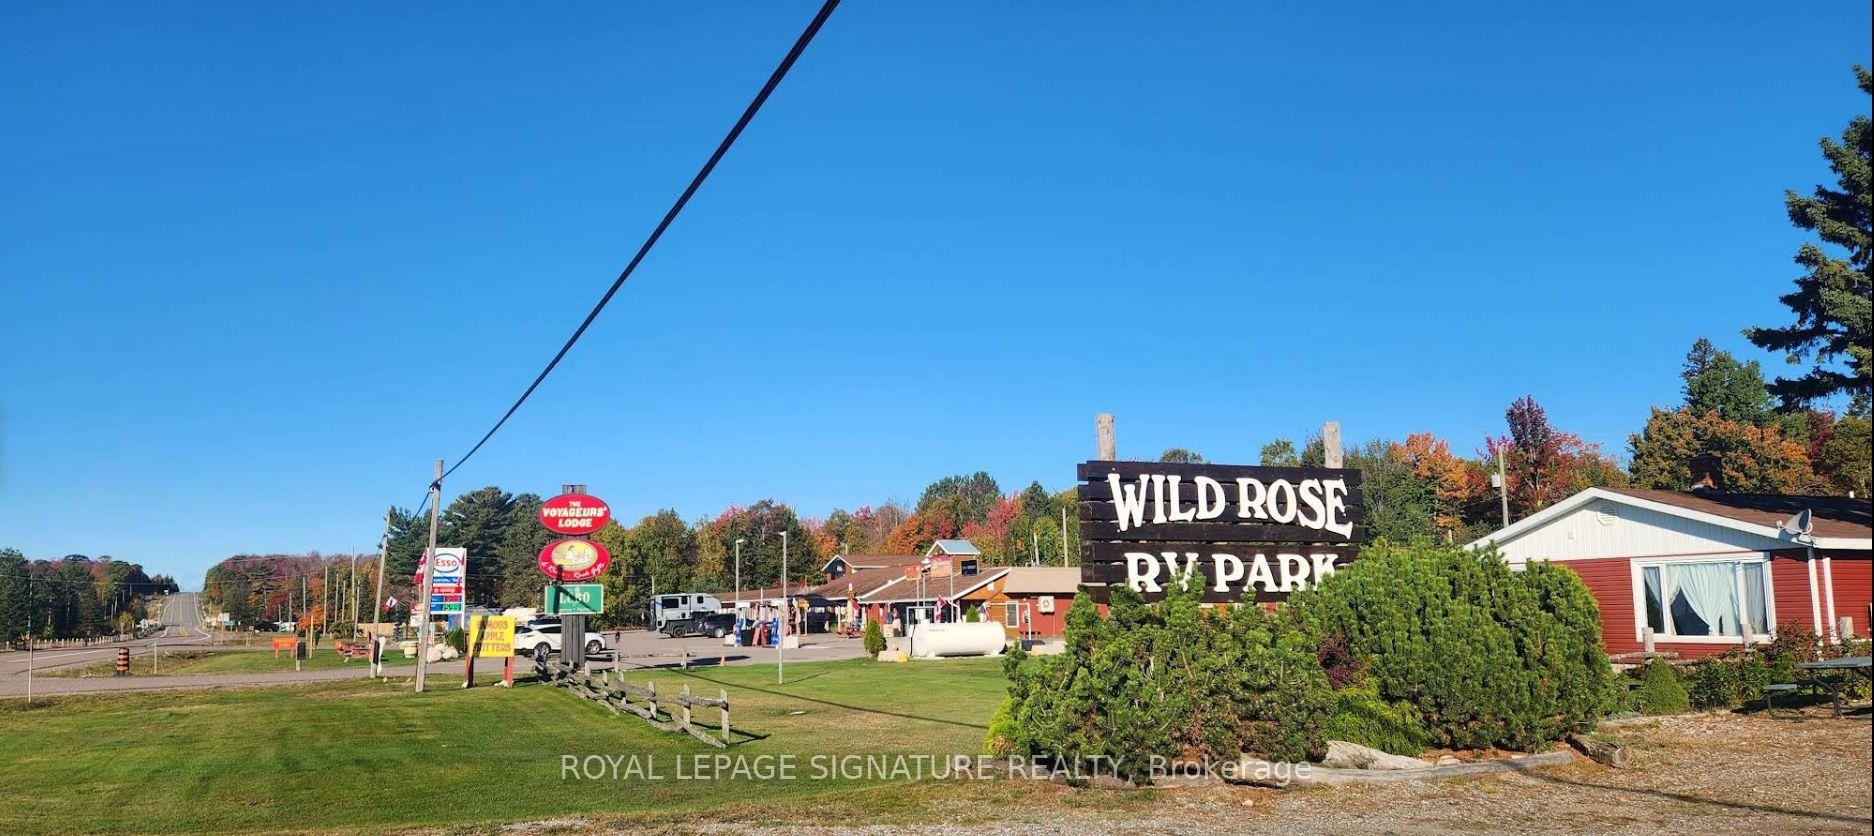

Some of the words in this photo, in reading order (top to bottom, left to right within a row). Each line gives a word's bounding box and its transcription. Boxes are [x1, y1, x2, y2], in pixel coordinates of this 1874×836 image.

[1107, 472, 1226, 532] WILD
[1235, 476, 1353, 539] ROSE
[542, 506, 607, 517] VOYAGEURS'
[558, 518, 592, 528] LODGE
[1124, 552, 1200, 592] RV
[1212, 553, 1339, 593] PARK
[476, 620, 508, 630] FAMOUS
